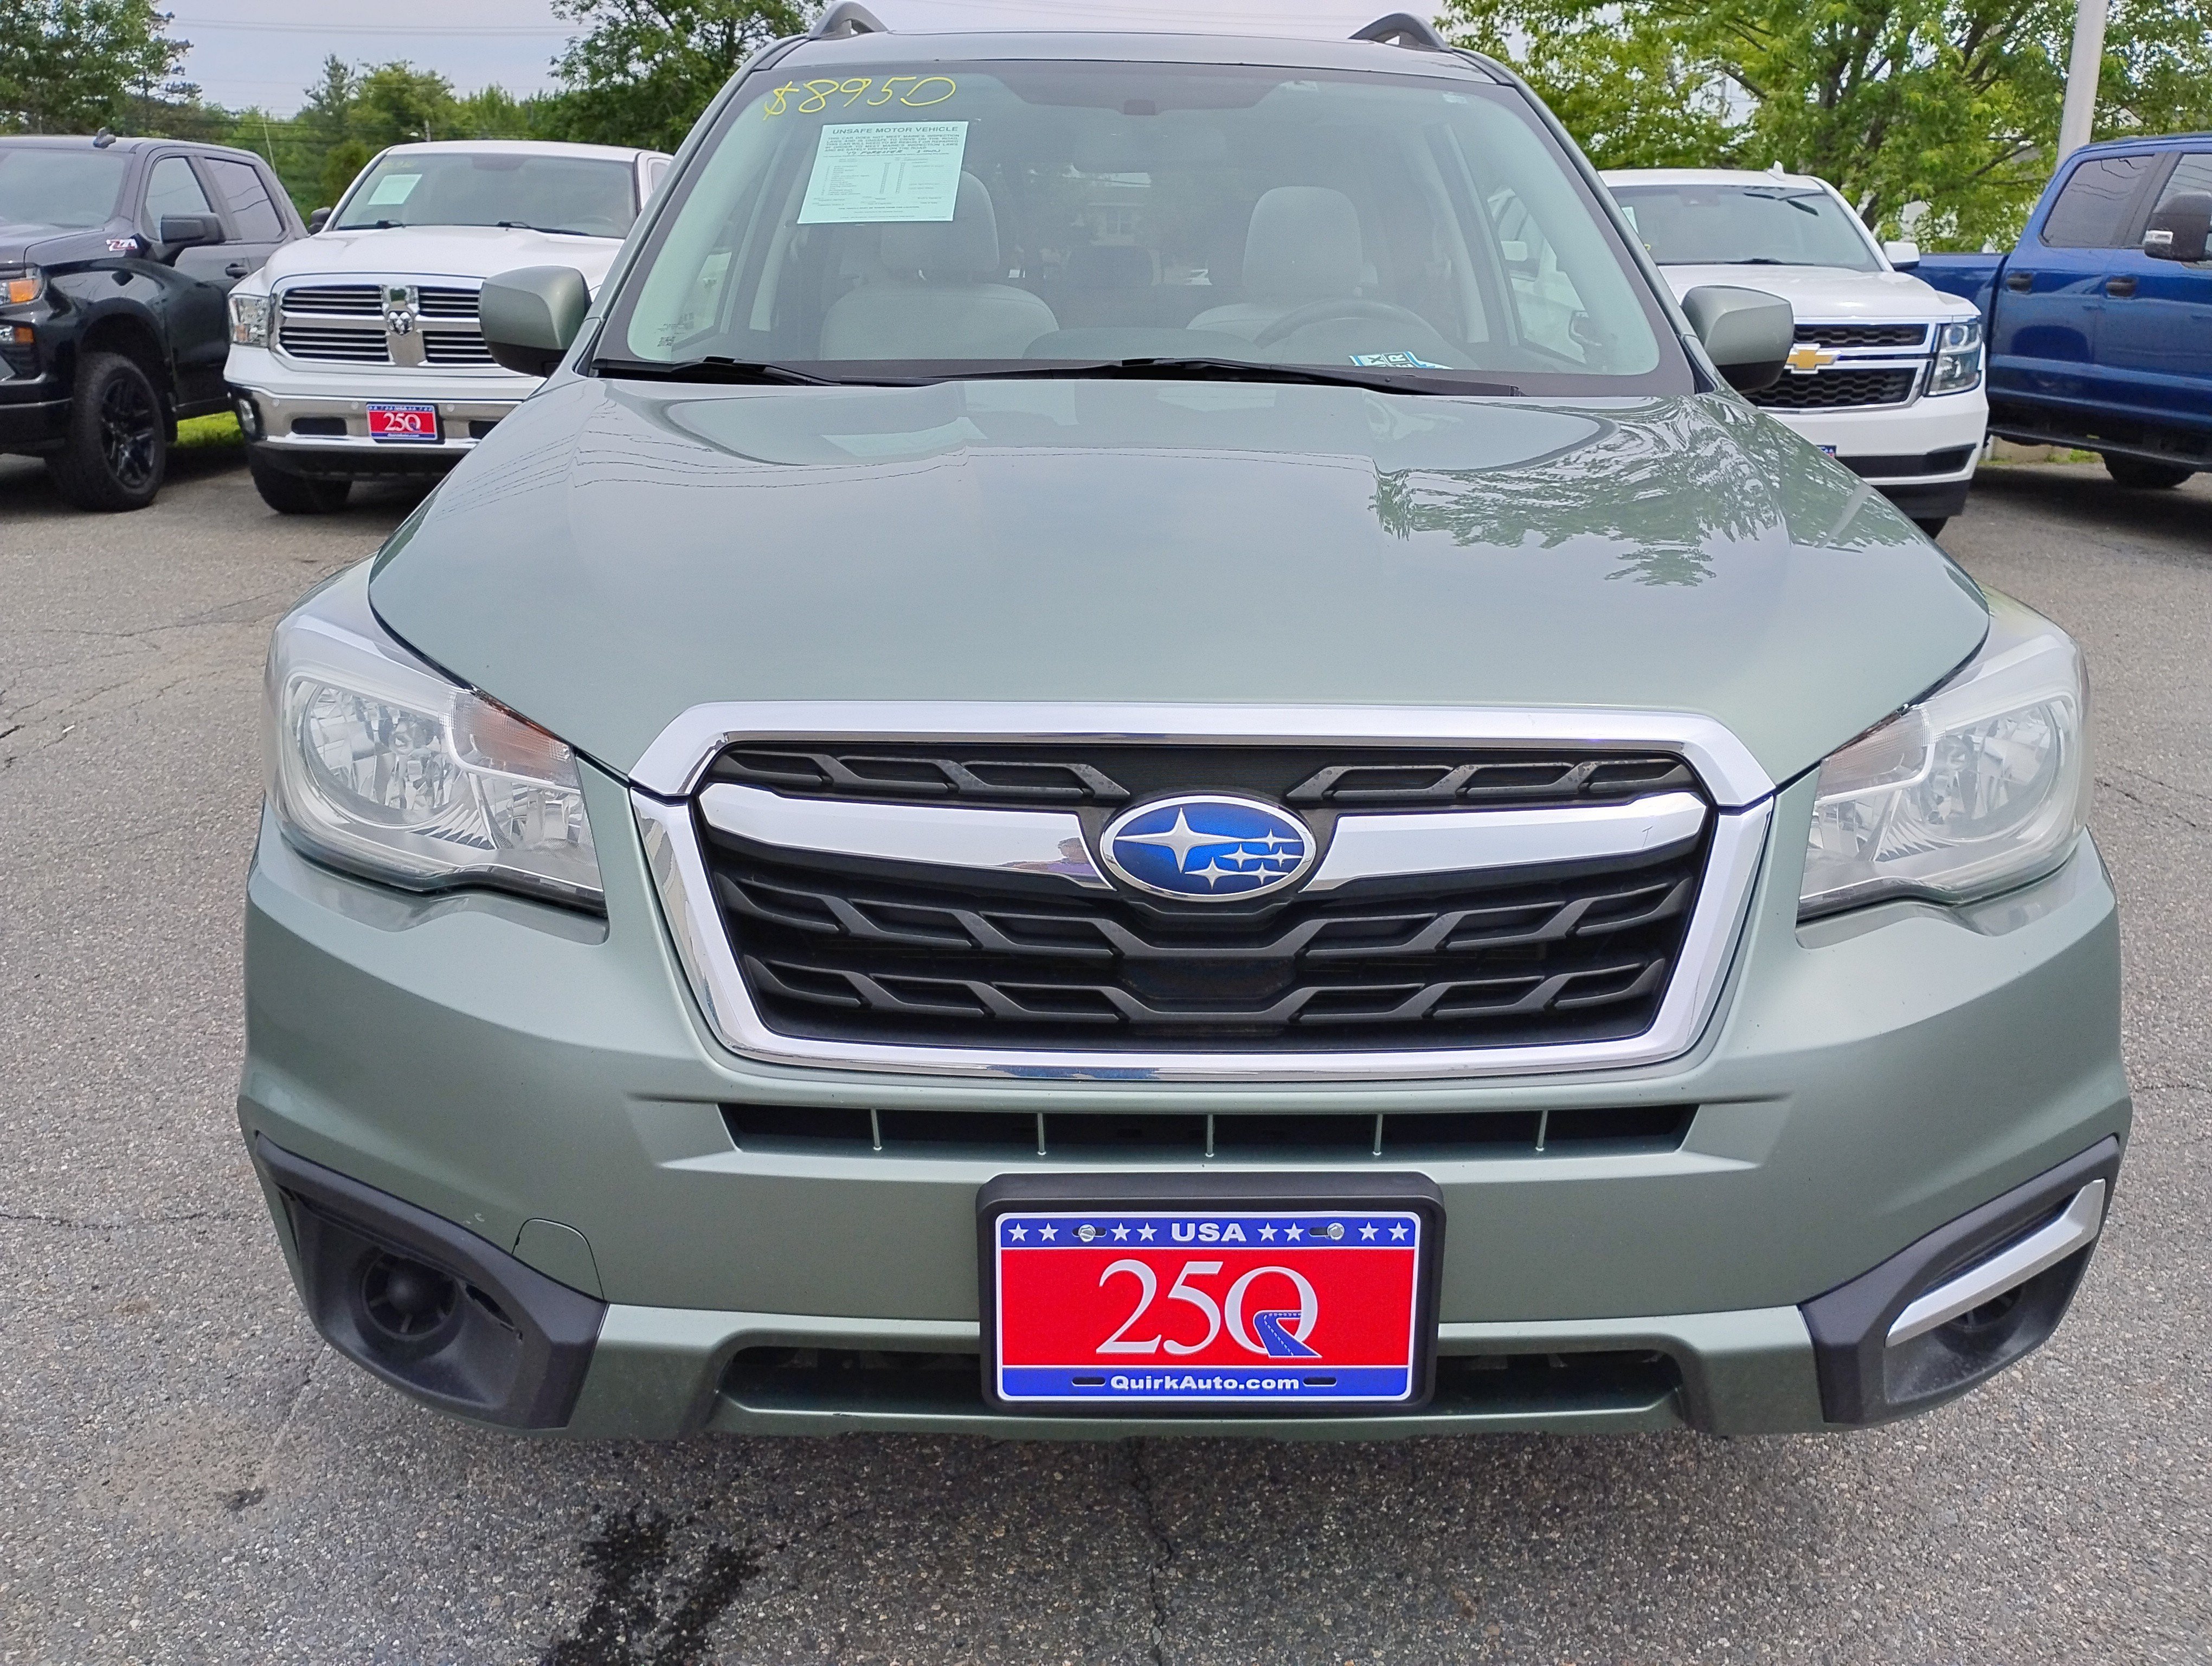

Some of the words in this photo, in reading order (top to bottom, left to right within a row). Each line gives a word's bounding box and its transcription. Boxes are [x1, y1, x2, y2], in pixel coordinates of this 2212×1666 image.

[762, 76, 956, 120] $8950
[383, 413, 423, 432] 25Q
[1172, 1222, 1247, 1242] USA
[1096, 1259, 1322, 1359] 25Q
[1110, 1375, 1300, 1391] QuirkAuto.com
